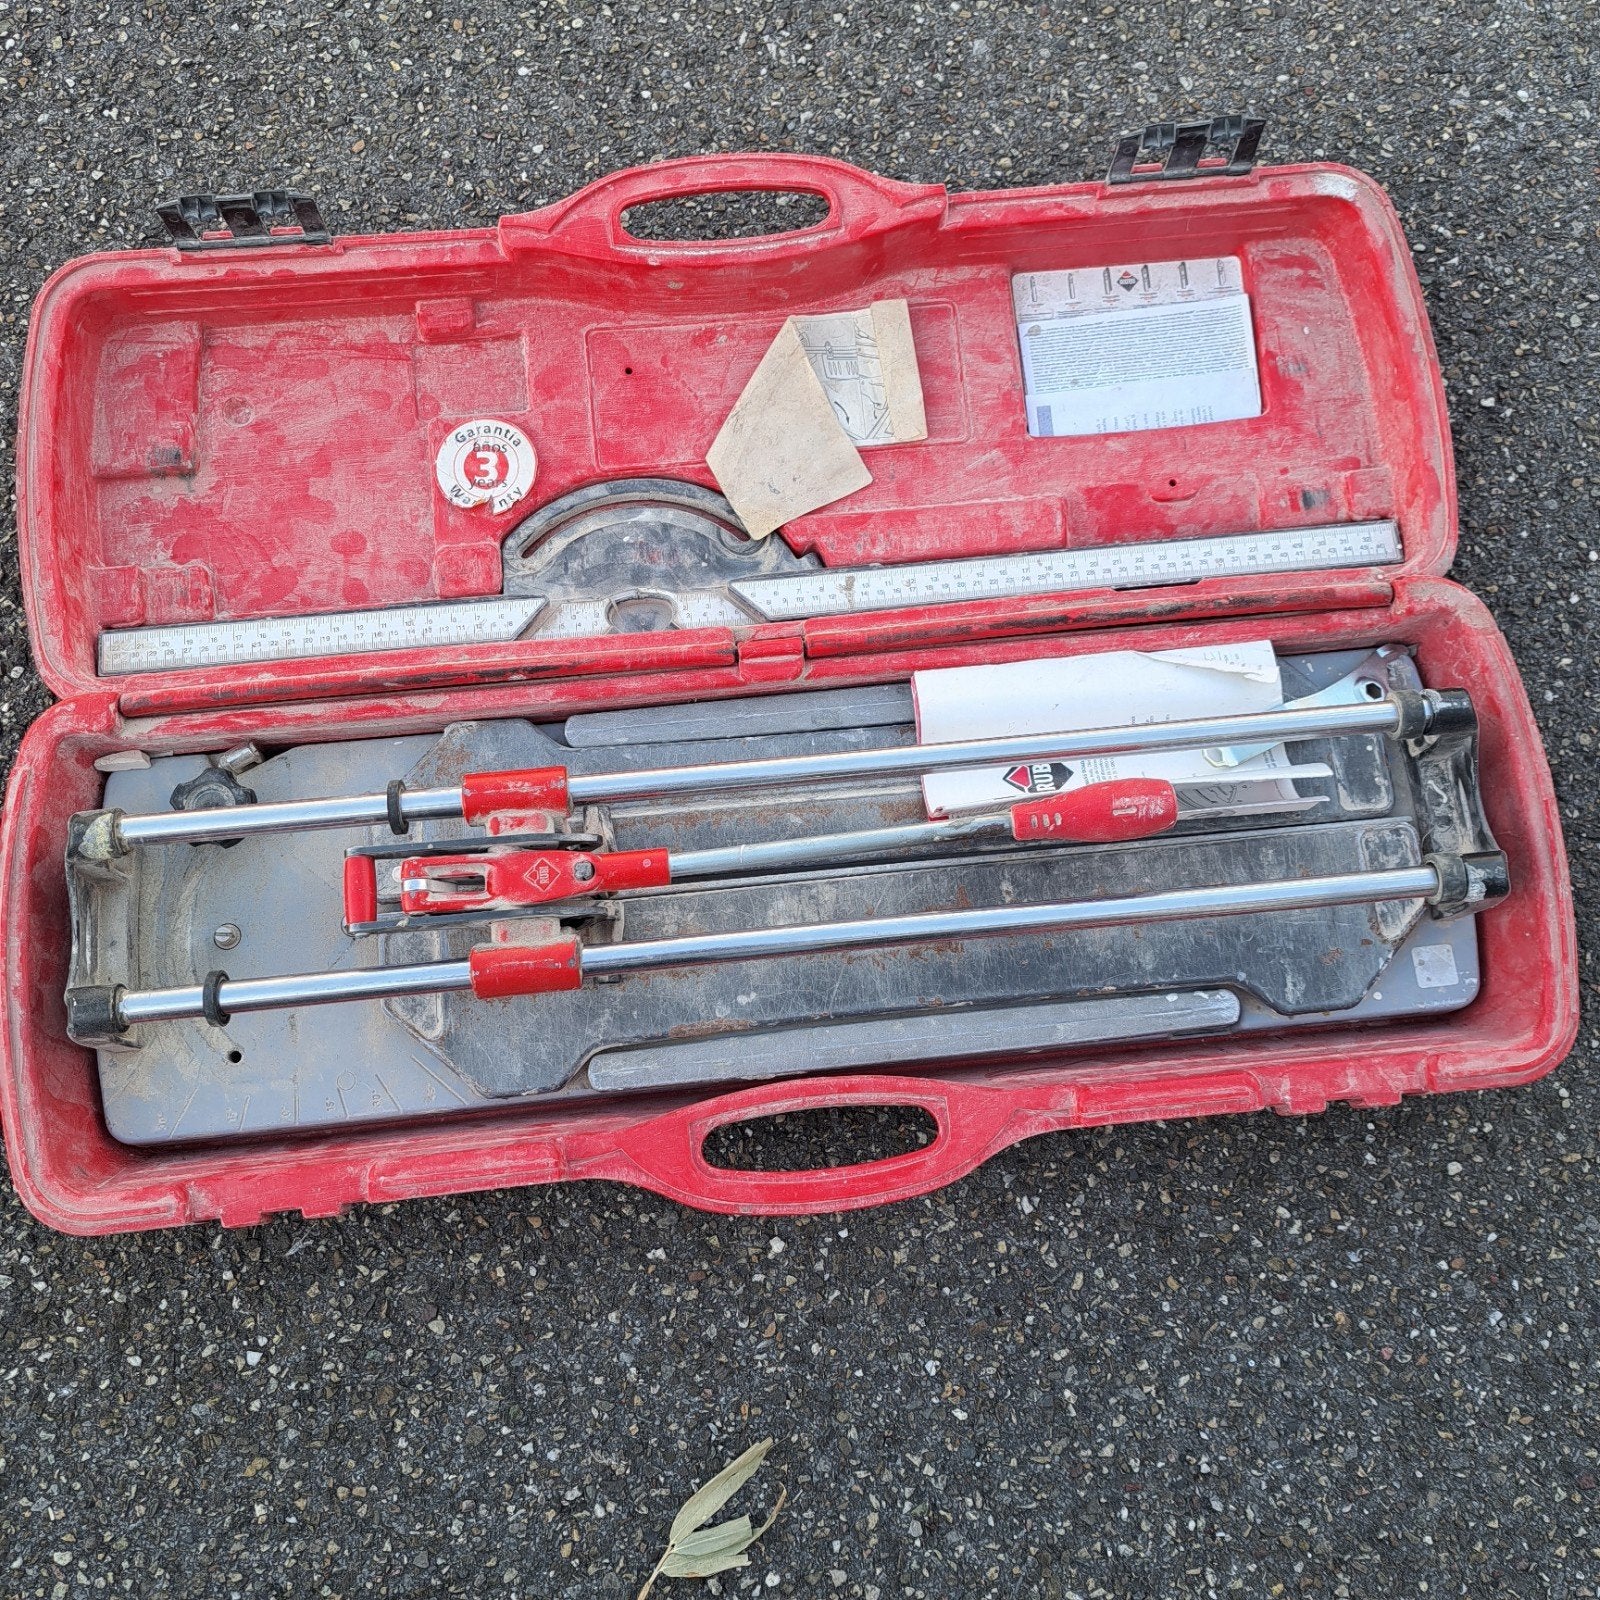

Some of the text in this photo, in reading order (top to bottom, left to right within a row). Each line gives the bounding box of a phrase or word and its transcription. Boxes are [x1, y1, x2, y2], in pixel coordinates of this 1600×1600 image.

[476, 451, 498, 480] 3
[470, 479, 508, 490] years
[1032, 763, 1056, 792] RUB
[539, 866, 550, 884] RUBI
